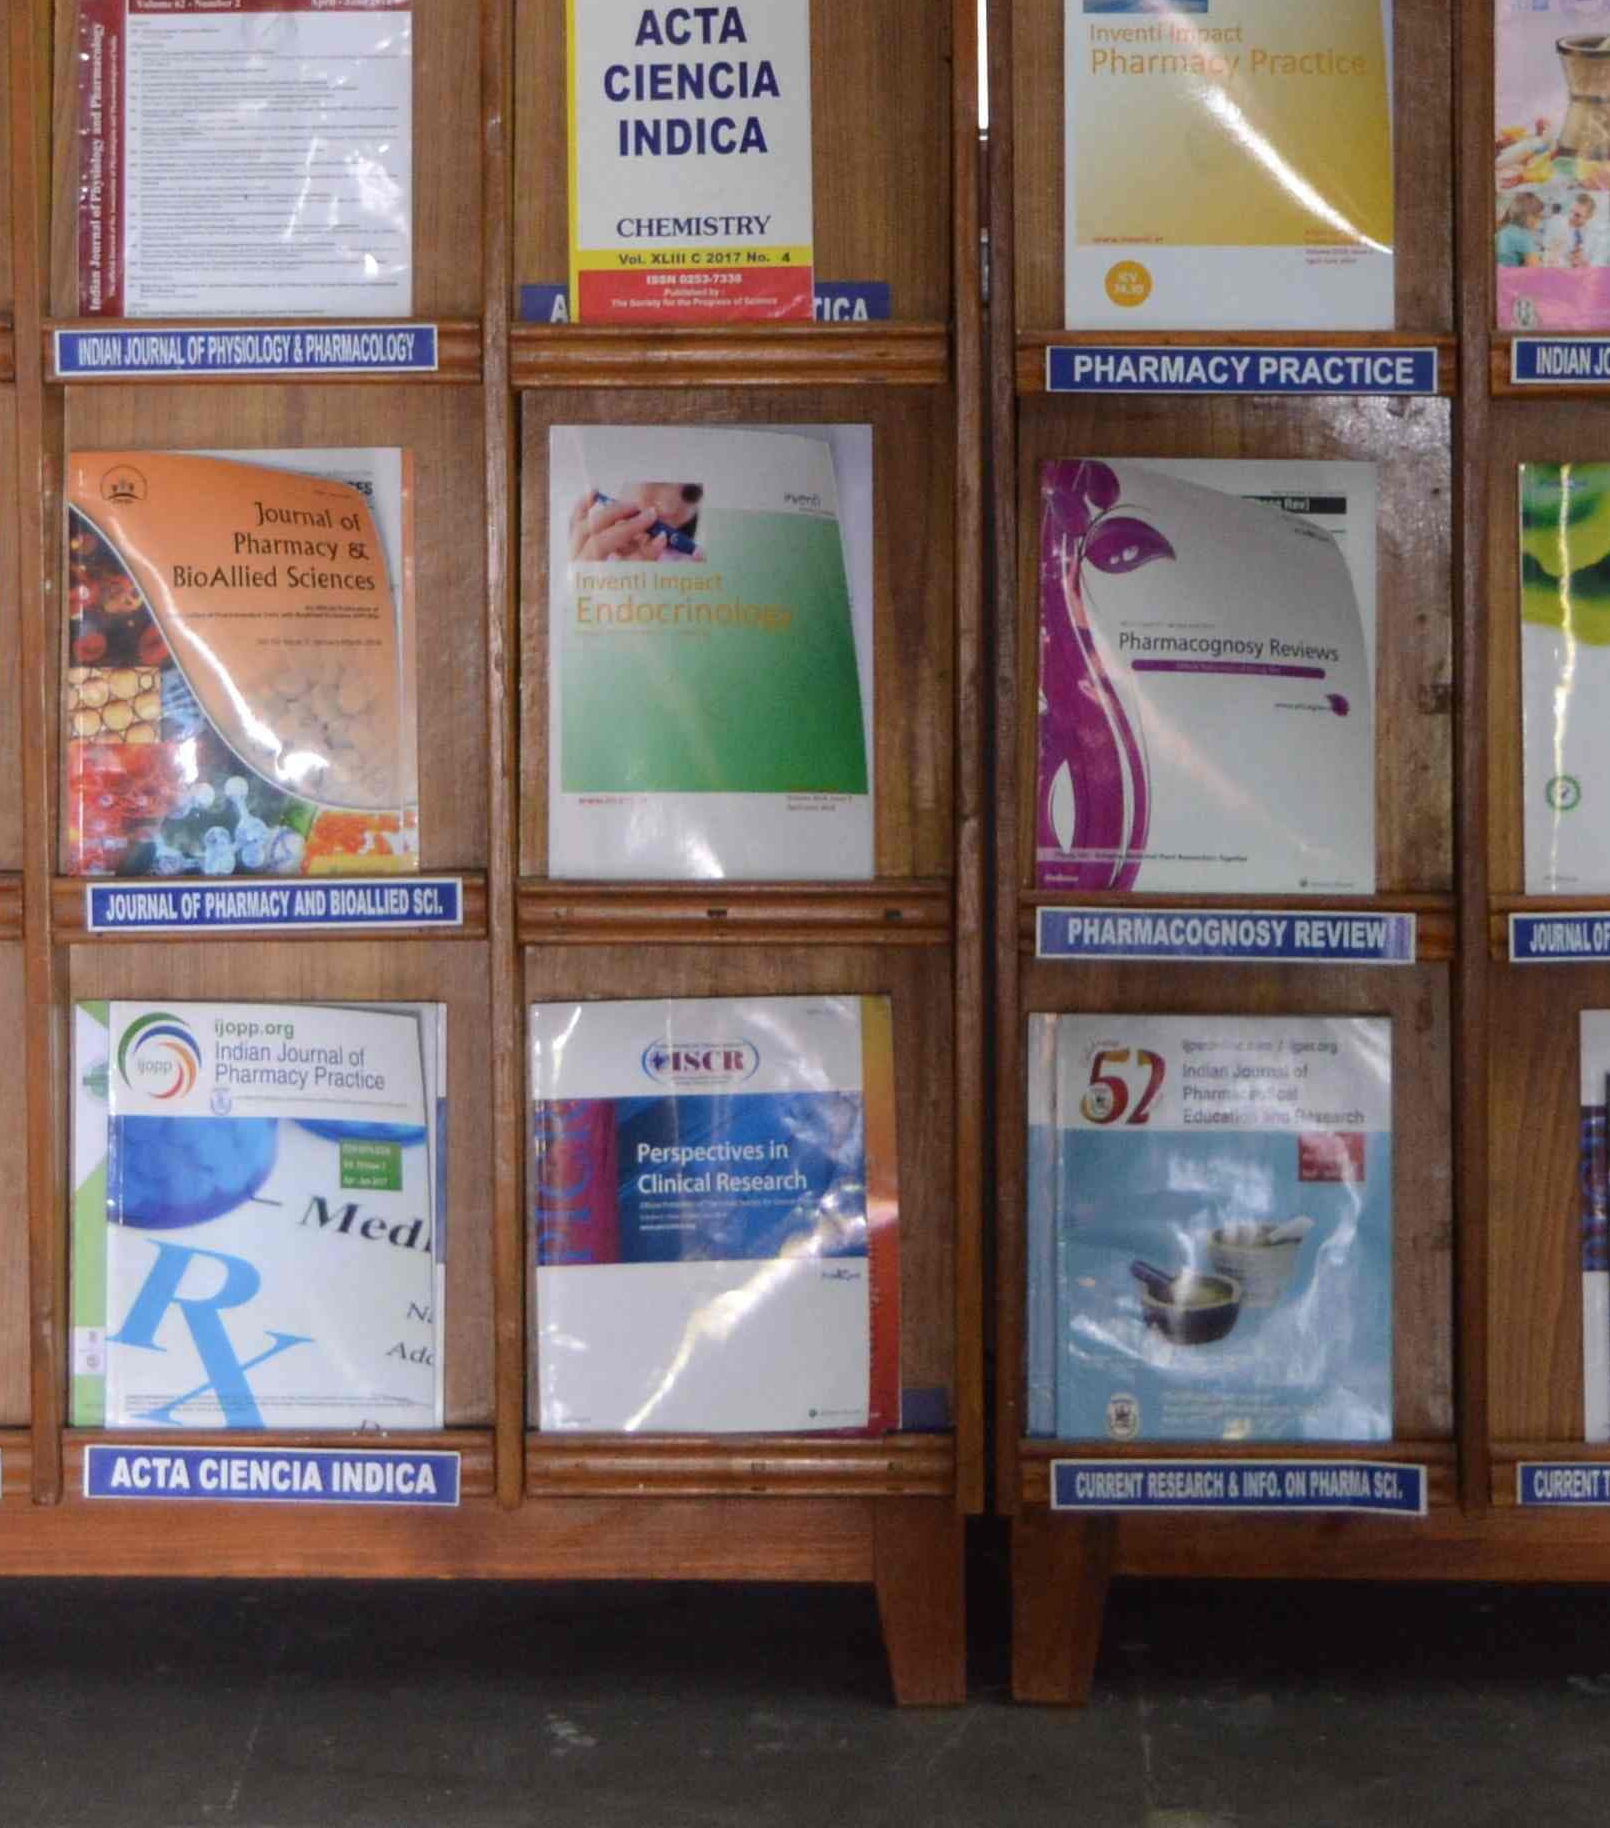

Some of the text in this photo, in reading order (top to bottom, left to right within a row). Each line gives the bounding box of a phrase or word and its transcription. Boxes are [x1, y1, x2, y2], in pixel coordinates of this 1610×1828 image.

[635, 6, 747, 46] ACTA
[604, 60, 780, 102] CIENCIA
[619, 116, 768, 157] INDICA
[616, 214, 772, 238] CHEMISTRY
[619, 252, 791, 265] Vol. XLIII C 2017 No. 4
[1074, 355, 1414, 385] PHARMACY PRACTICE
[1536, 347, 1590, 376] INDIAN
[254, 501, 362, 531] Journal of
[1119, 632, 1340, 663] Pharmacognosy Reviews
[106, 888, 444, 922] JOURNAL OF PHARMACY AND BIOALLIED SCI.
[1067, 916, 1387, 949] PHARMACOGNOSY REVIEW
[215, 1042, 367, 1066] Indian Journal of
[671, 1050, 744, 1072] ISCR
[215, 1064, 386, 1091] Pharmacy Practice
[637, 1140, 789, 1166] Perspectives in
[637, 1169, 808, 1194] Clinical Research
[110, 1457, 437, 1494] ACTA CIENCIA INDICA
